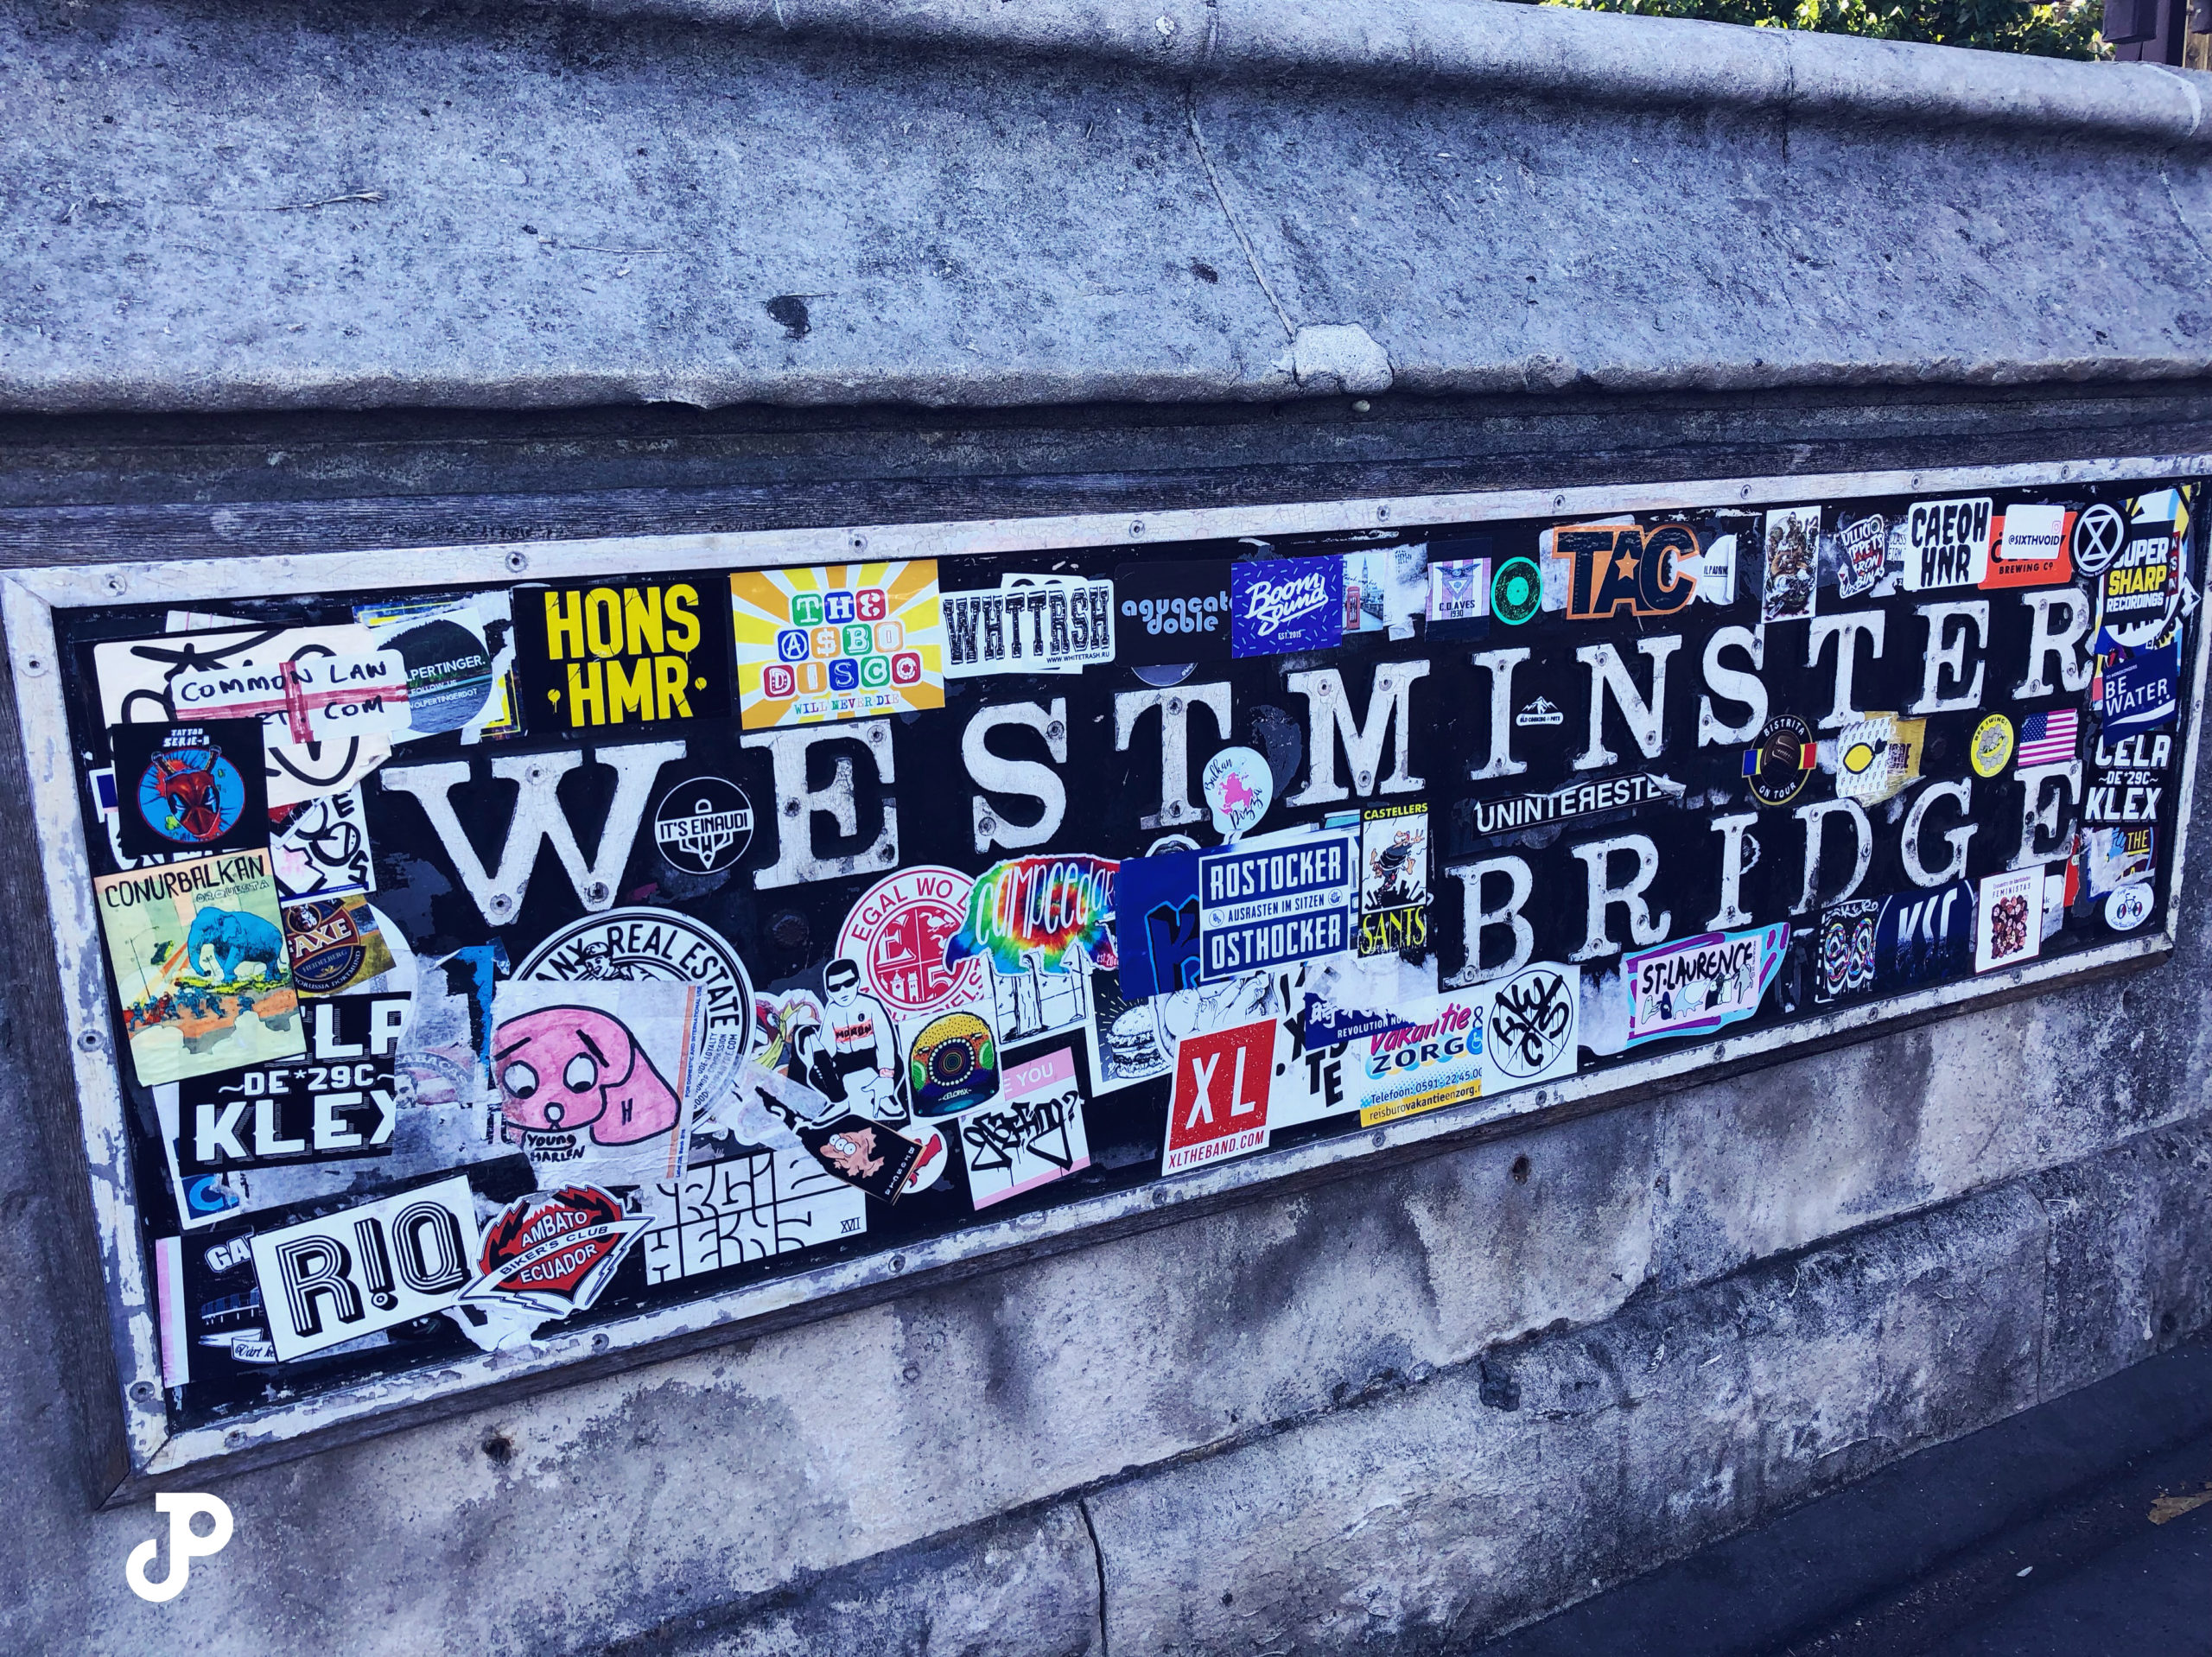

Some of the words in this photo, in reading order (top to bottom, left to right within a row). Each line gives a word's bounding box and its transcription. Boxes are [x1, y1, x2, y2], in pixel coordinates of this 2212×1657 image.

[1911, 502, 1987, 549] CAEOH
[2008, 534, 2060, 546] @SIXTHVOID
[1552, 524, 1700, 619] TAC
[1921, 543, 1972, 585] HNR
[1999, 563, 2040, 575] BREWING
[2108, 565, 2167, 596] SHARP
[544, 583, 702, 660] HONS
[794, 591, 882, 625] THE
[1450, 609, 1464, 619] 1930
[2106, 592, 2164, 613] RECORDINGS
[943, 586, 1110, 665] WHTTRSH
[1147, 612, 1219, 635] doble
[181, 667, 314, 702] COMMON
[329, 660, 388, 683] LAW
[410, 682, 445, 695] FOLLOW
[445, 679, 458, 689] US
[566, 655, 694, 727] HMR
[767, 656, 918, 695] DISCO
[2106, 676, 2127, 700] BE
[795, 701, 828, 715] WILL
[831, 696, 873, 711] NEVER
[876, 693, 899, 706] DIE
[1764, 718, 1806, 737] BISTRITA
[380, 588, 2094, 928] WESTMINSTER
[1204, 757, 1233, 792] Balkan
[1230, 787, 1264, 830] Pizza
[1758, 784, 1771, 799] ON
[1773, 781, 1796, 799] TOUR
[2084, 786, 2163, 821] KLEX
[659, 821, 689, 840] IT'S
[691, 812, 747, 835] EINAUDI
[1363, 803, 1429, 822] CASTELLERS
[2127, 829, 2150, 851] THE
[105, 854, 265, 909] CONURBALKAN
[195, 878, 270, 904] ORQUESTA
[1209, 845, 1342, 901] ROSTOCKER
[1441, 757, 2082, 989] BRIDGE
[1992, 882, 2031, 898] FEMINISTAS
[1228, 902, 1280, 923] AUSRASTEN
[1281, 899, 1294, 916] IM
[1294, 895, 1325, 915] SITZEN
[1211, 913, 1342, 970] OSTHOCKER
[1361, 905, 1426, 956] SANTS
[331, 949, 362, 987] DORTMUND
[607, 924, 678, 961] REAL
[678, 941, 740, 1029] ESTATE
[1642, 941, 1753, 995] ST.LAURENCE
[685, 1056, 695, 1087] DOMESTIC
[690, 1000, 701, 1043] INTERNATIONAL
[835, 1024, 872, 1039] MORON
[1338, 1018, 1389, 1038] REVOLUTION
[1370, 1036, 1465, 1075] ZORG
[1015, 1062, 1054, 1088] YOU
[1185, 1045, 1256, 1131] XL
[1371, 1087, 1414, 1105] Telefoon:
[1167, 1129, 1265, 1170] XLTHEBAND.COM
[884, 1146, 916, 1197] Brescia
[521, 1210, 588, 1248] AMBATO
[499, 1240, 559, 1276] BIKER'S
[566, 1226, 608, 1242] CLUB
[520, 1243, 598, 1284] ECUADOR
